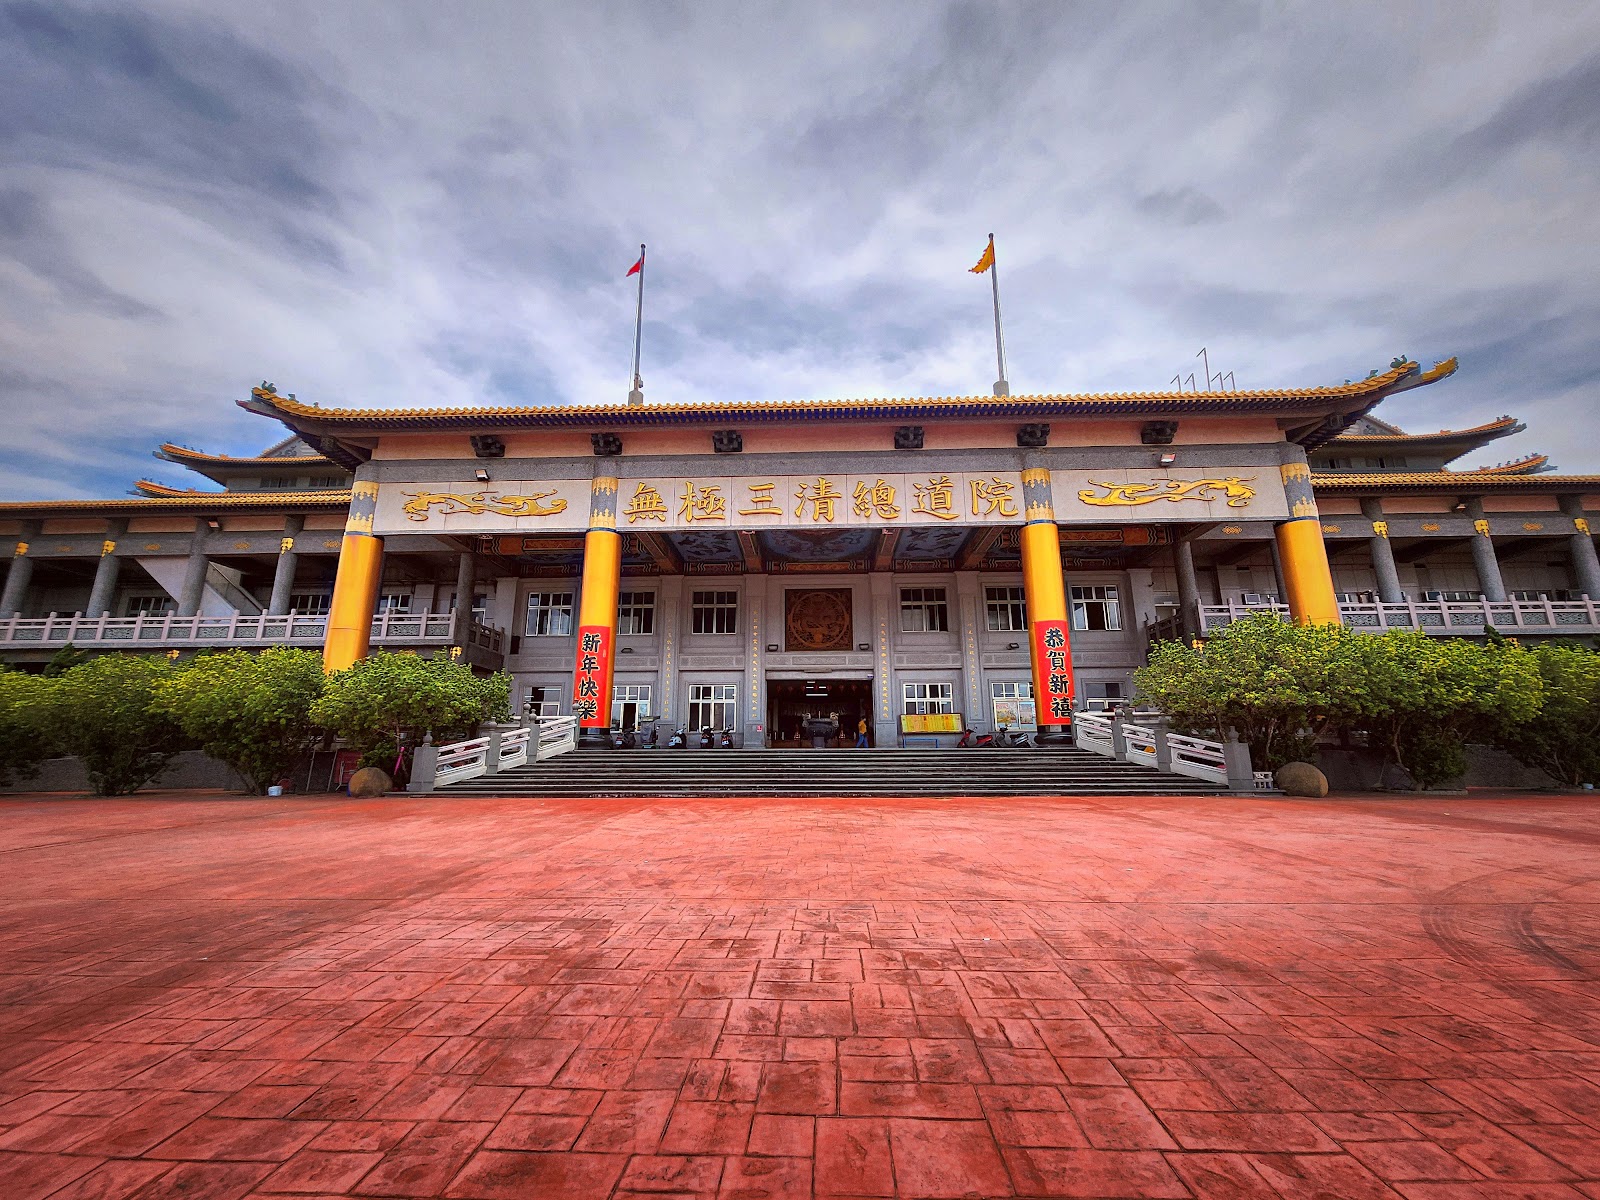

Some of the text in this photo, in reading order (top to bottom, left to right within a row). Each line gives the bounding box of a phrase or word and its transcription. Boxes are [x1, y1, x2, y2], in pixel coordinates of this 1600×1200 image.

[623, 476, 1019, 523] 無極三清總道院
[578, 632, 602, 720] 新年快樂
[1044, 627, 1073, 718] 恭賀新禧
